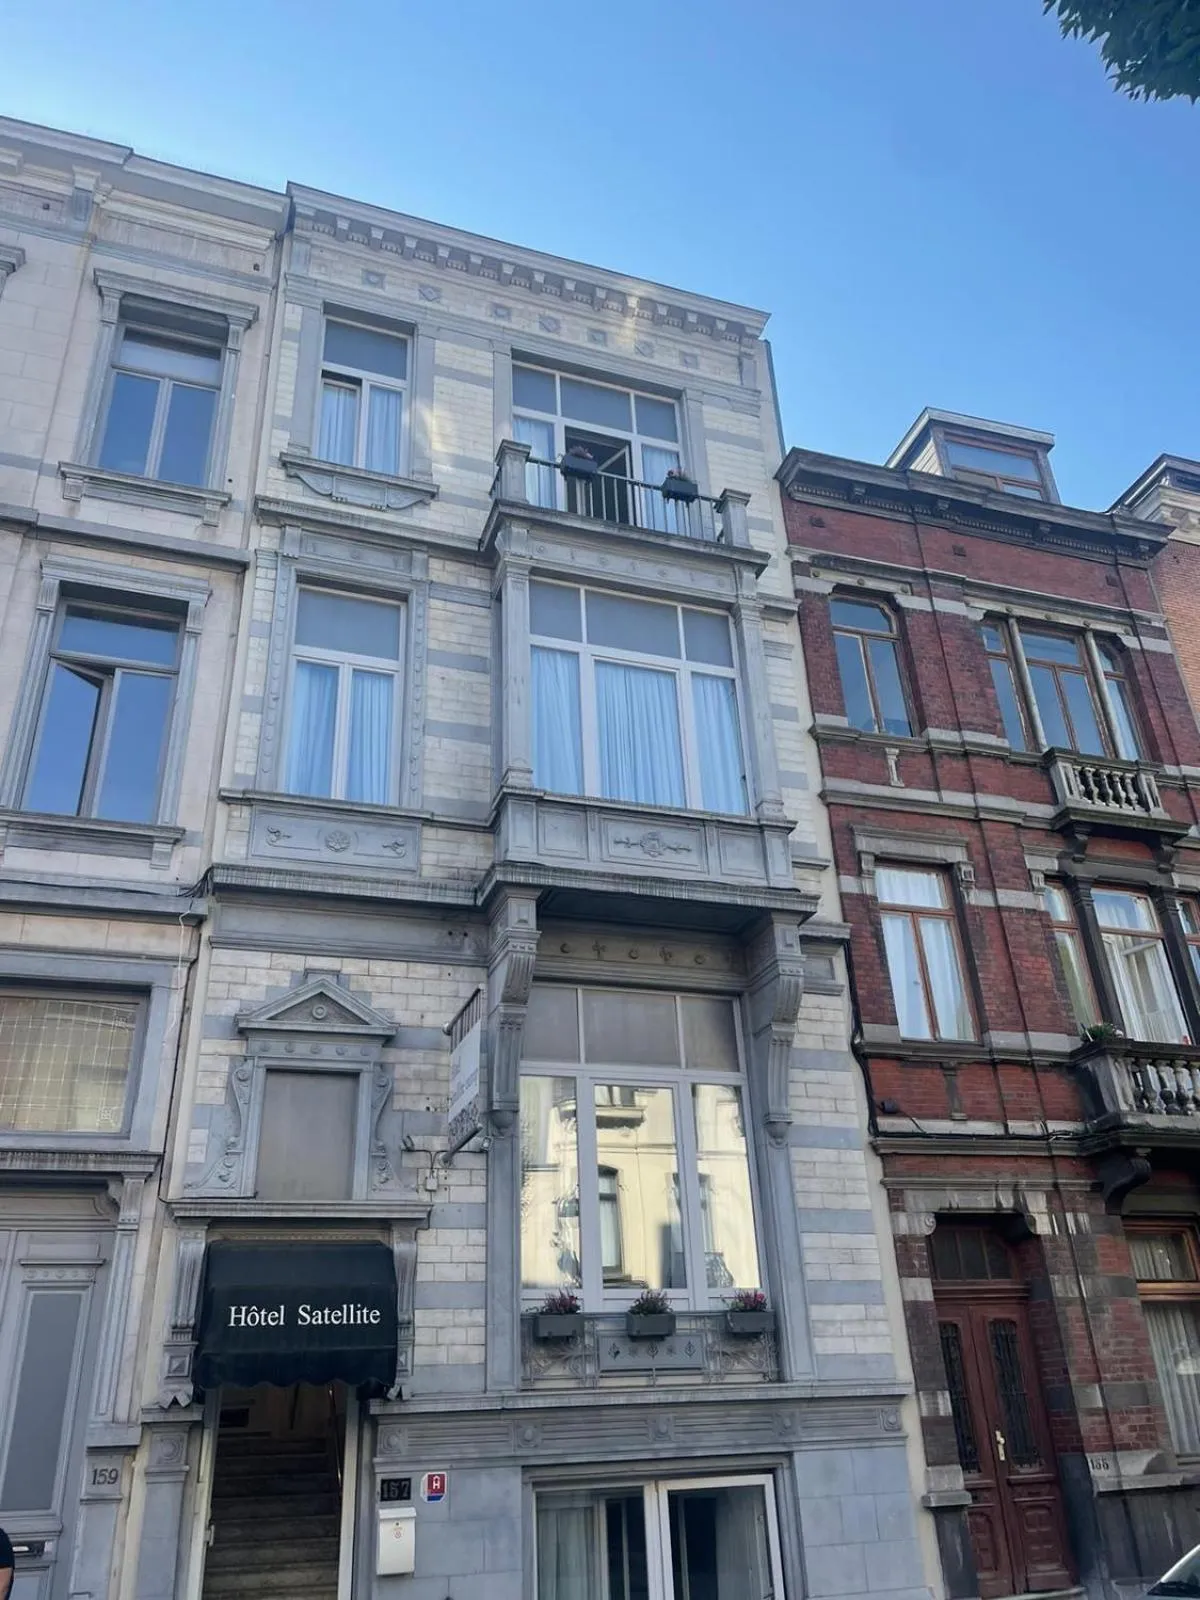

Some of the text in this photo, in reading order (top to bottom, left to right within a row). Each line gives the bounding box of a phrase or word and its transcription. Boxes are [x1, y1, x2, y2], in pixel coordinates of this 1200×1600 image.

[228, 1304, 381, 1327] Hôtel Satellite
[92, 1468, 119, 1485] 159
[382, 1480, 410, 1498] 157
